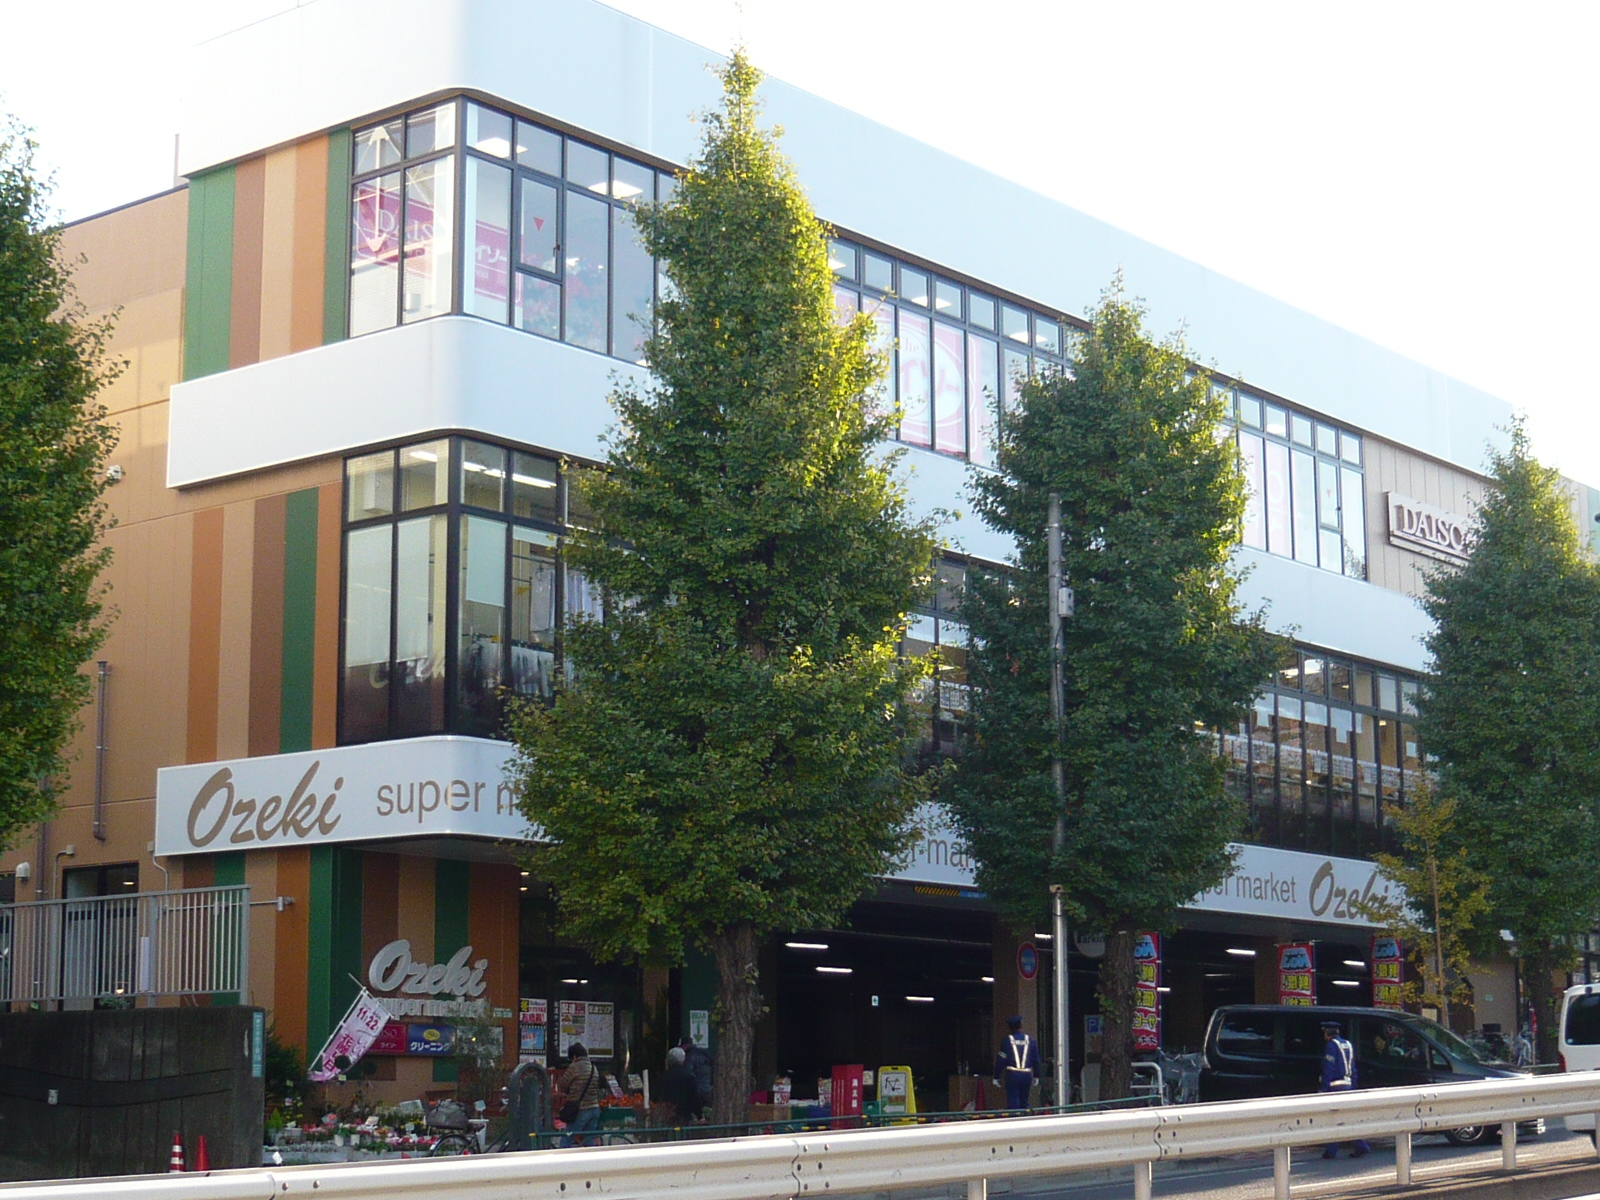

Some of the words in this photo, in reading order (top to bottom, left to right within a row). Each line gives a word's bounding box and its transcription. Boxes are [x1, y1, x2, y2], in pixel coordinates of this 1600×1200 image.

[1395, 504, 1466, 551] DAISO
[186, 760, 344, 848] Ozeki
[376, 779, 486, 823] super
[1236, 872, 1297, 904] market
[369, 939, 489, 997] Ozeki
